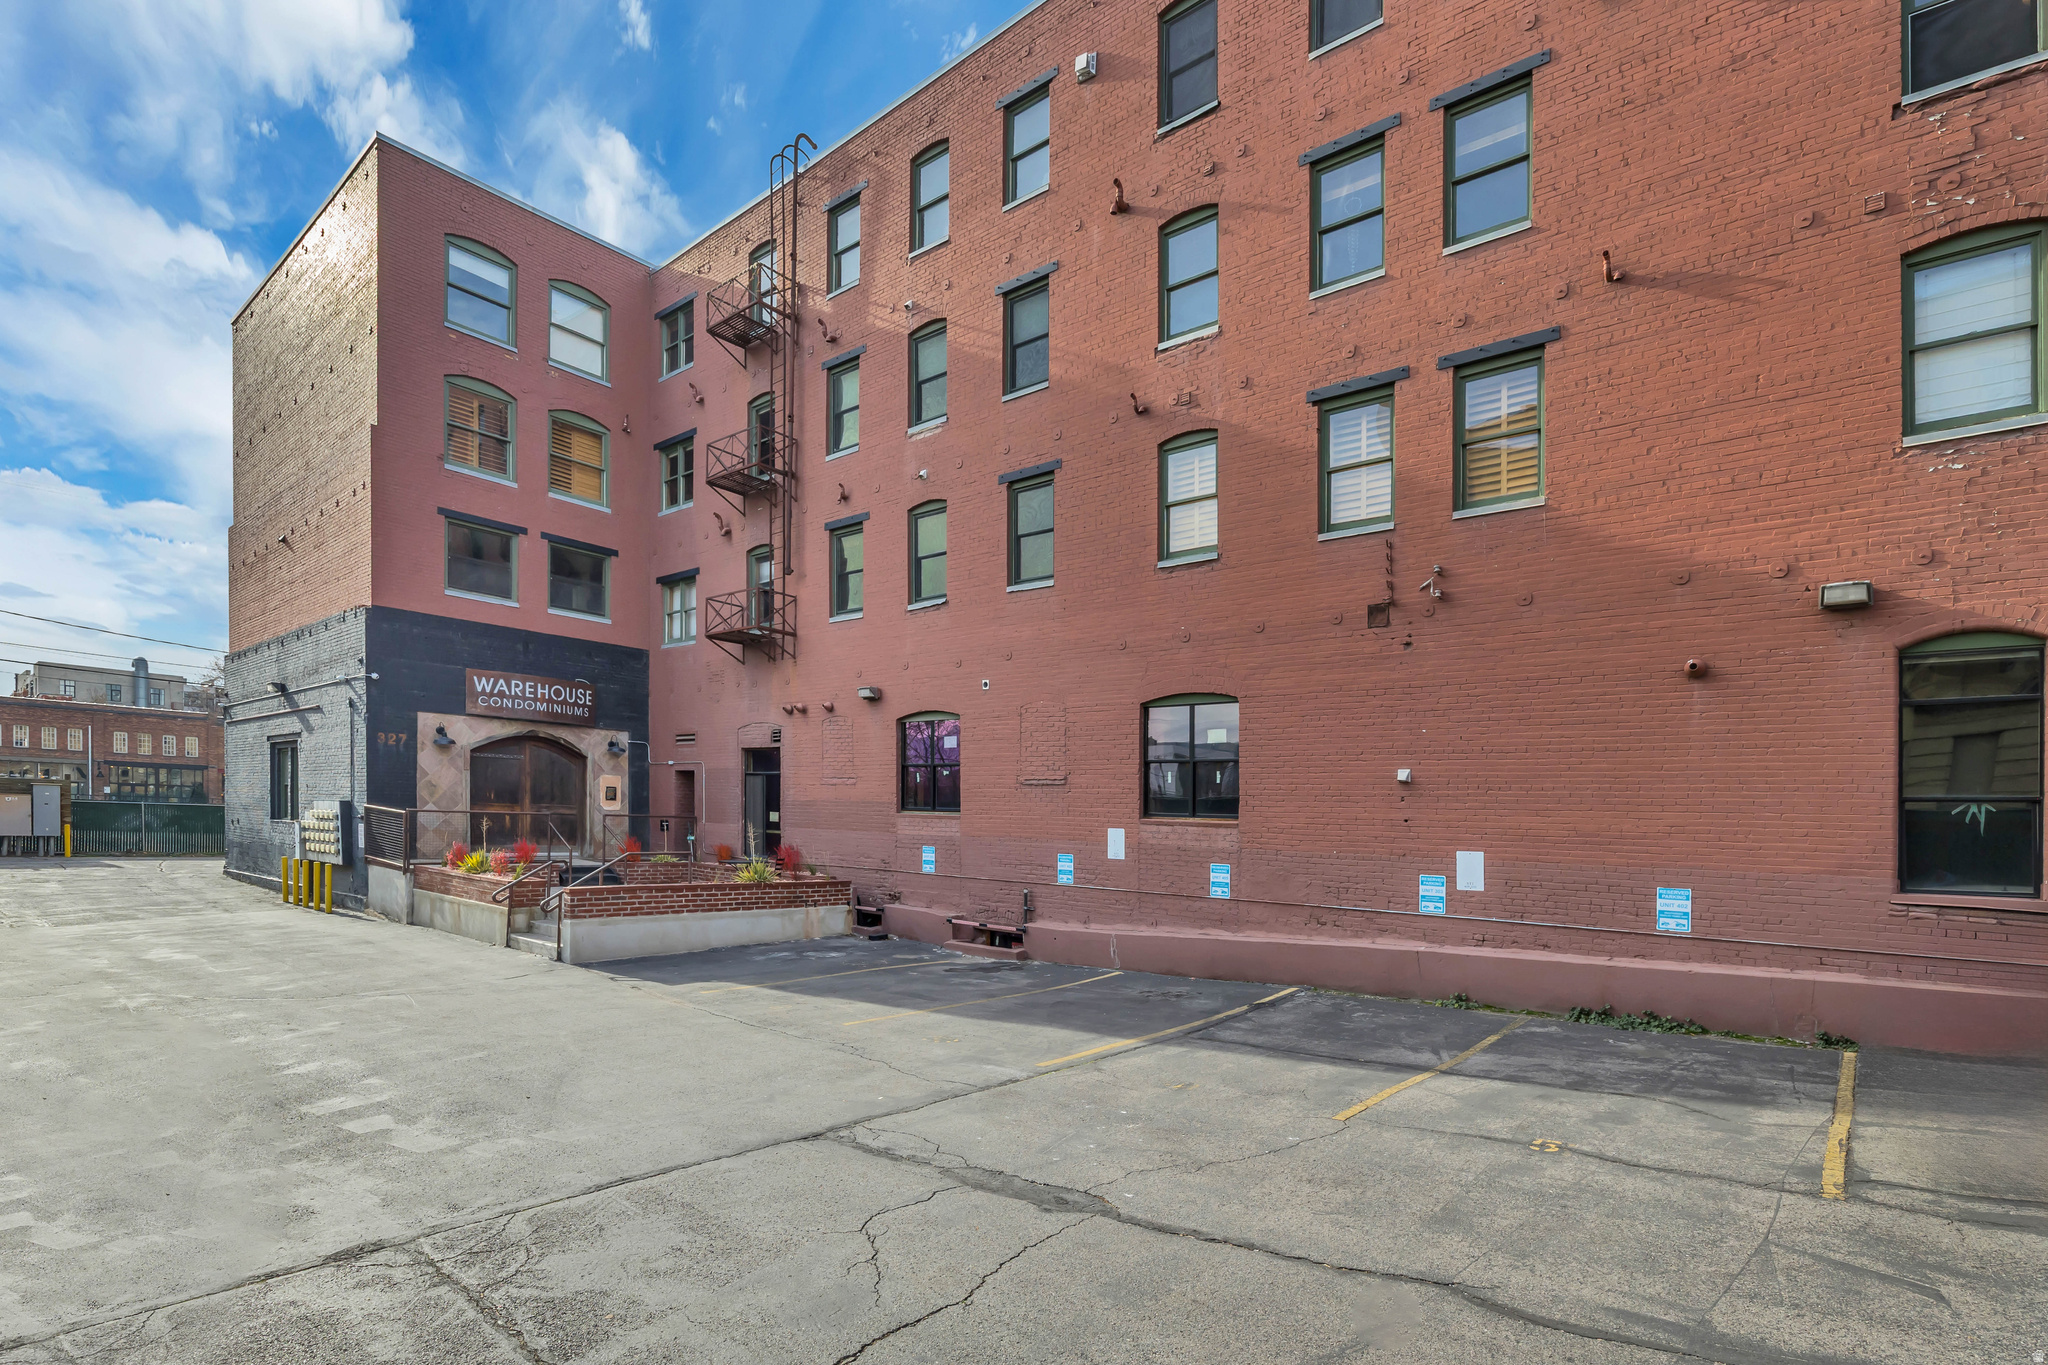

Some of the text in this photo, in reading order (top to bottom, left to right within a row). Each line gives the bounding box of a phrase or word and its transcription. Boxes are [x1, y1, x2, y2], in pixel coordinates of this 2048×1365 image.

[473, 675, 592, 706] WAREHOUSE
[478, 695, 589, 717] CONDOMINIUMS
[377, 732, 407, 745] 327
